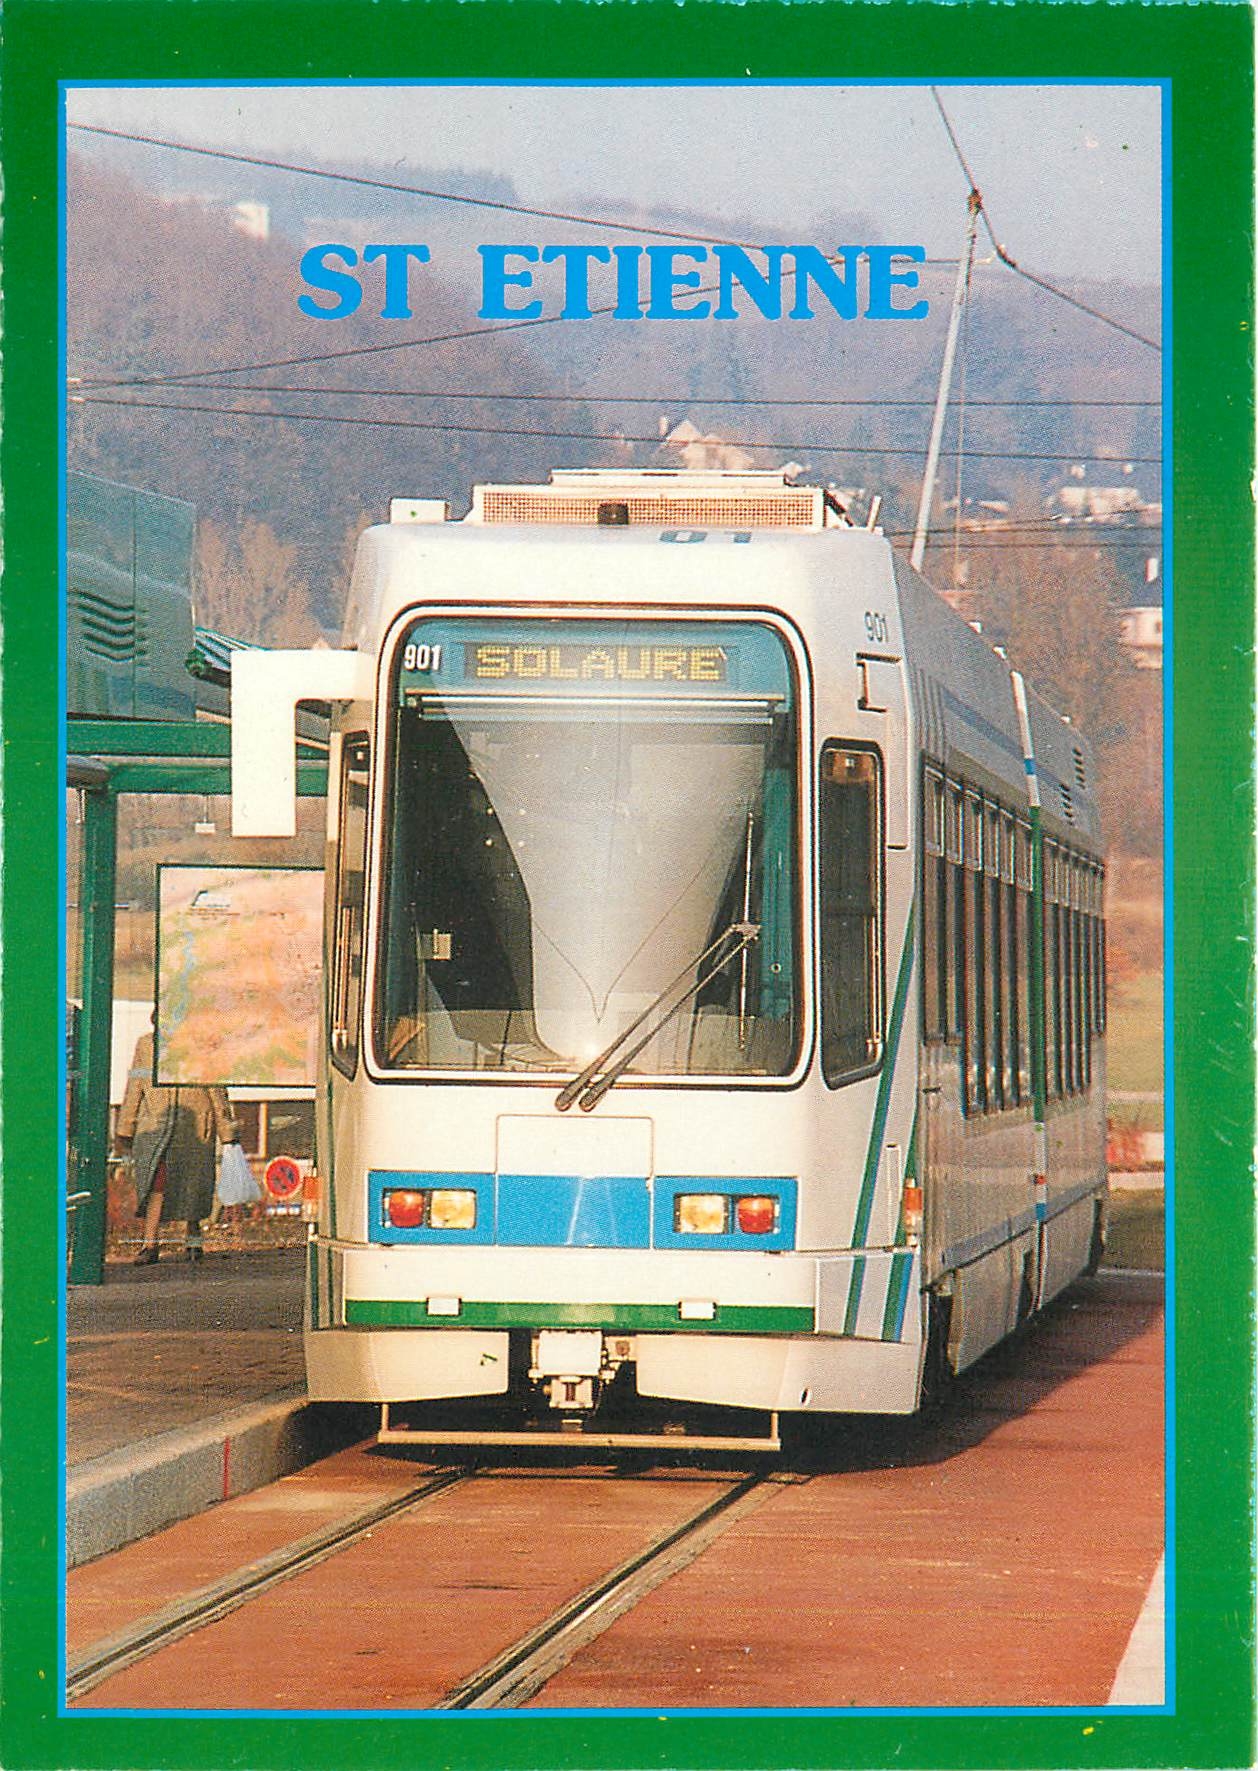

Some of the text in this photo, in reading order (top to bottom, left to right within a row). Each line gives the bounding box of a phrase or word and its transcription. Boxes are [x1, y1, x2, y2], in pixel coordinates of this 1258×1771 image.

[865, 611, 889, 643] 901
[404, 644, 441, 671] 901
[475, 645, 721, 682] SOLAURE
